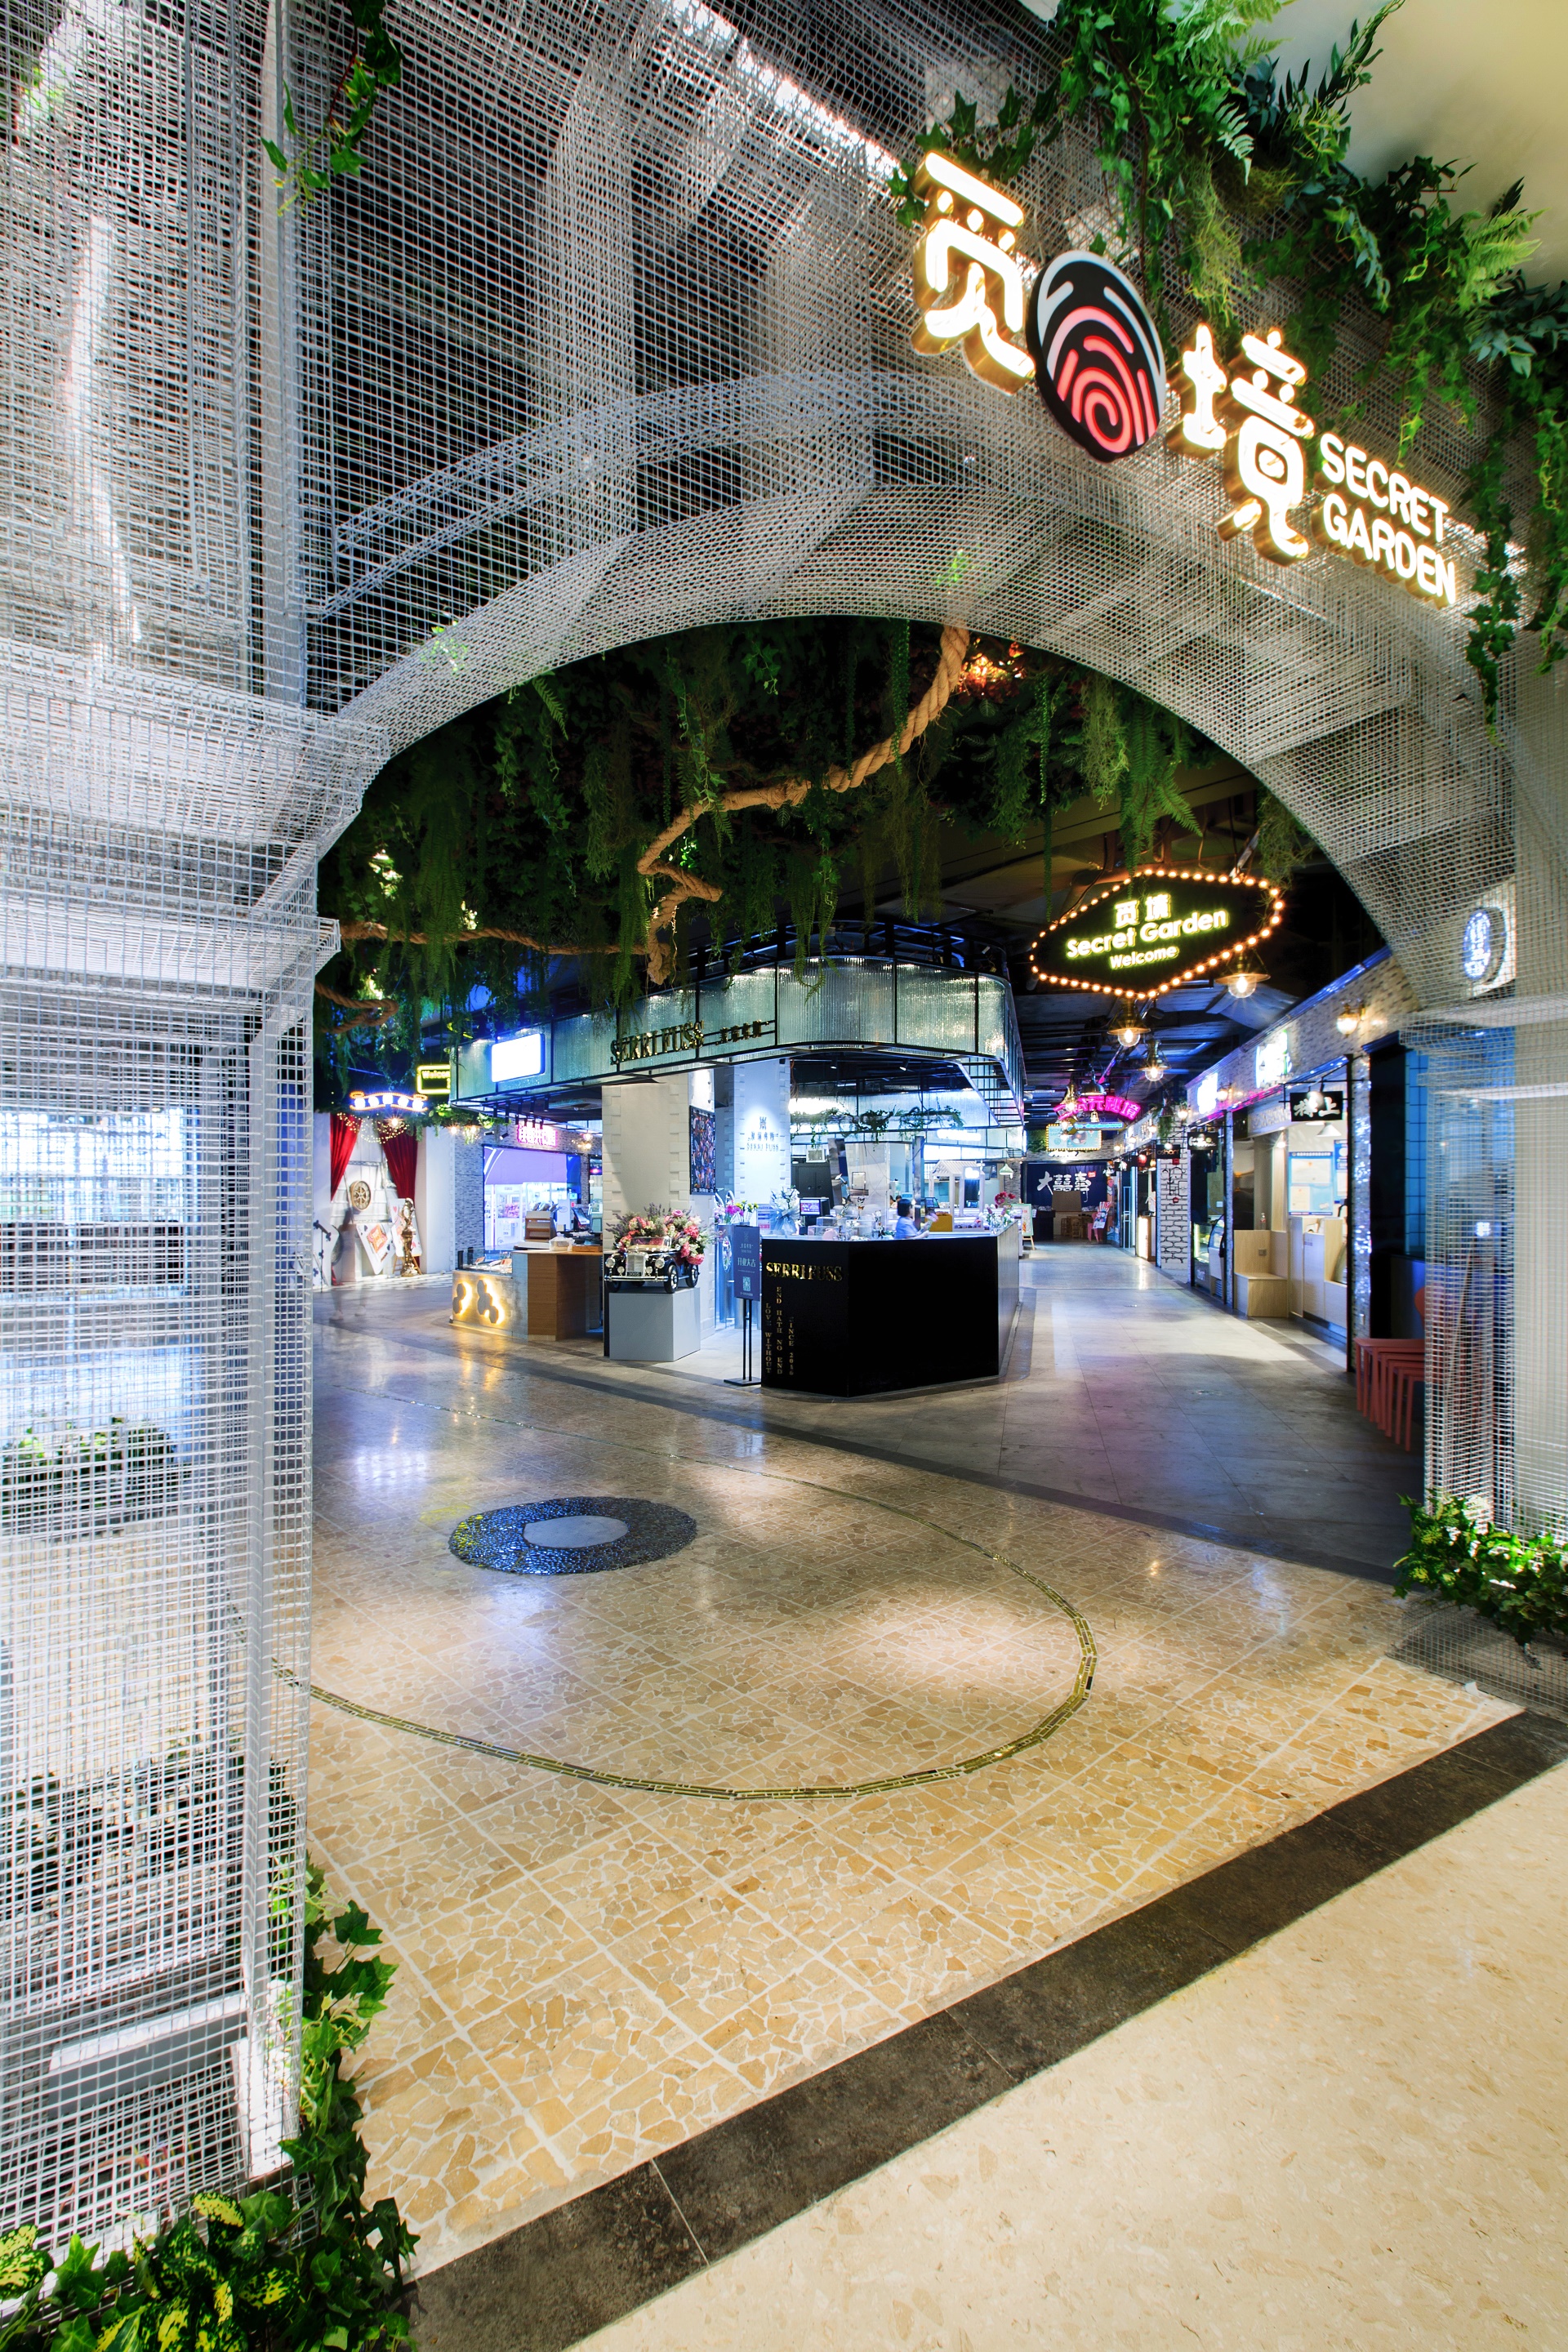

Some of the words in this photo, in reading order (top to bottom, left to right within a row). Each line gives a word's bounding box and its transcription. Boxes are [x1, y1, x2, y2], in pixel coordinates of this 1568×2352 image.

[1321, 433, 1449, 542] SECRET
[1323, 493, 1455, 604] GARDEN
[1066, 927, 1136, 959] Secret
[1140, 910, 1227, 942] Garden
[1110, 946, 1178, 969] Welcome
[777, 1339, 782, 1351] NO
